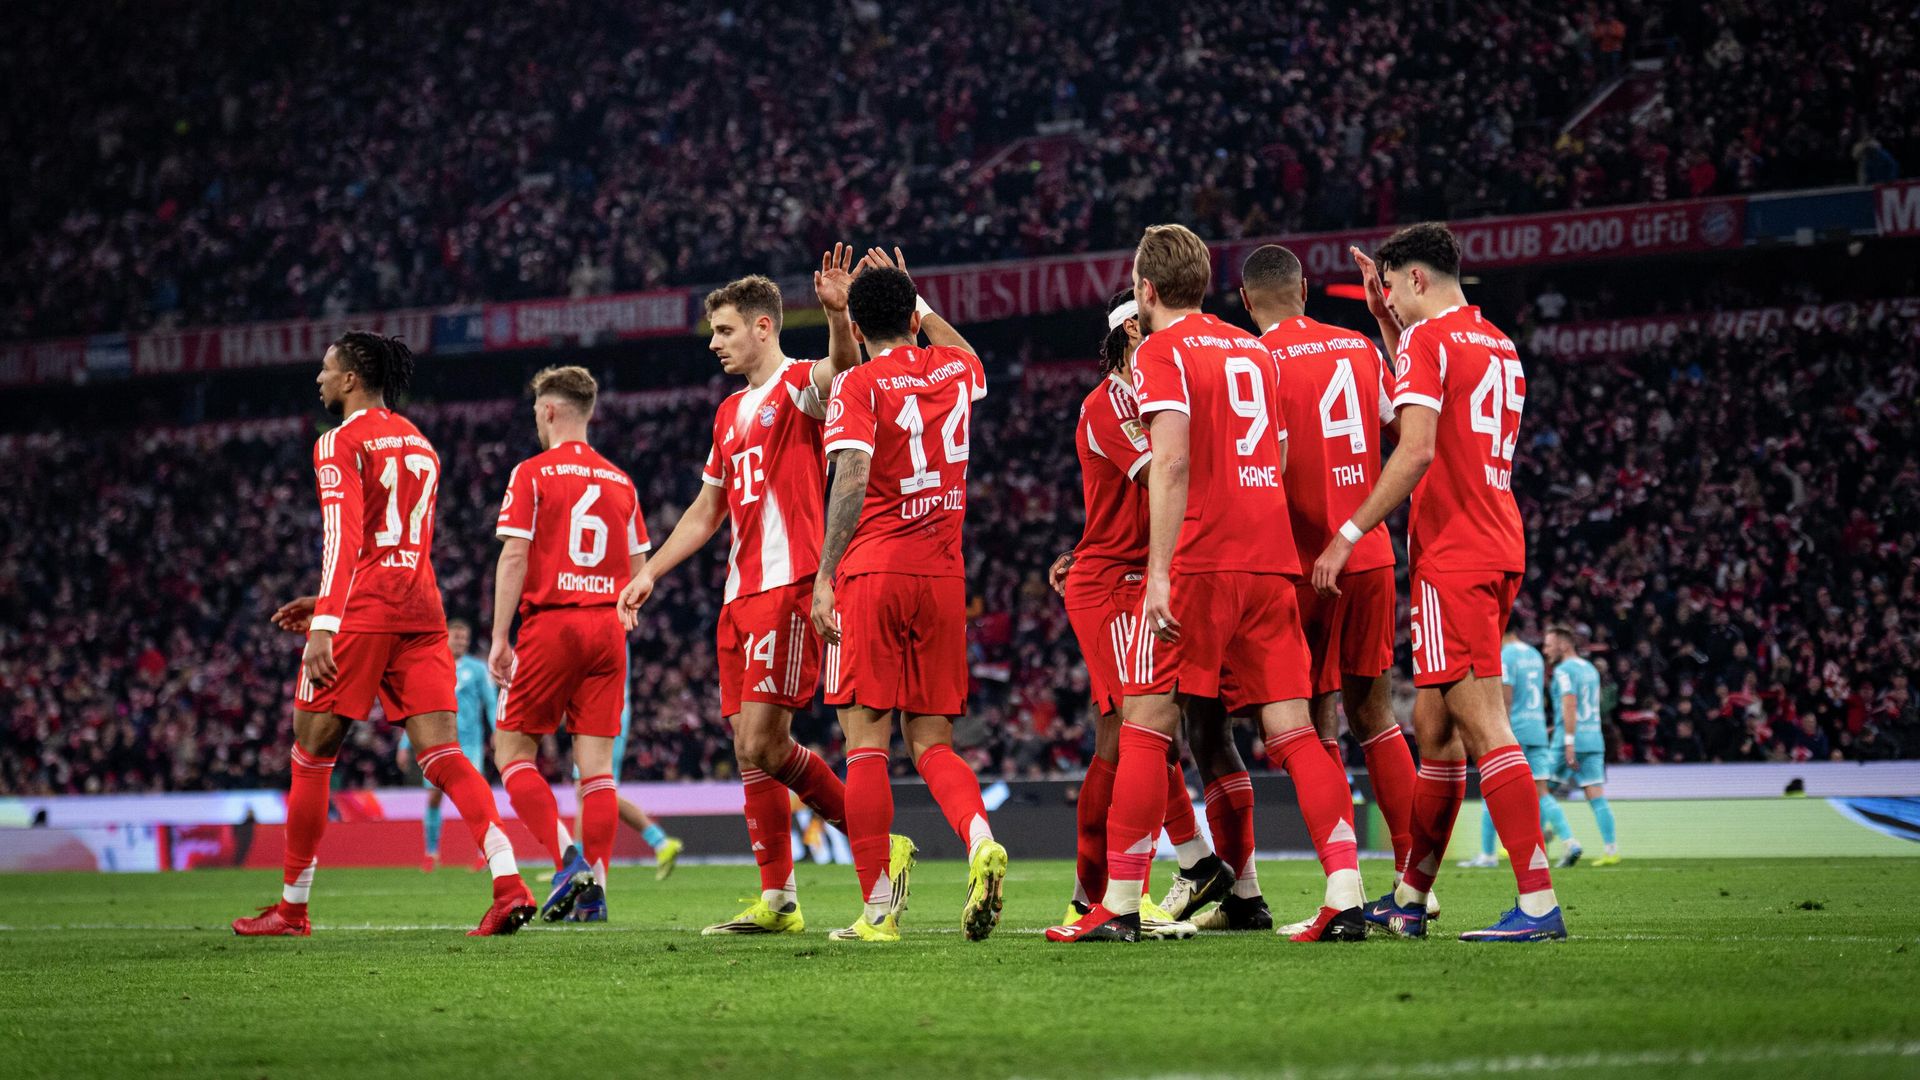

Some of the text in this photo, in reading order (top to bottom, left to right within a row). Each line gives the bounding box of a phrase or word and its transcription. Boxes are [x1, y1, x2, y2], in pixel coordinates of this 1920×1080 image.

[1457, 223, 1541, 262] CLUB
[1551, 216, 1624, 255] 2000
[1183, 336, 1199, 348] FC
[1450, 332, 1466, 343] FC
[1271, 349, 1286, 362] FC
[1286, 341, 1326, 357] BAYERN
[877, 379, 891, 390] FC
[1224, 356, 1269, 457] 9
[1318, 357, 1367, 455] 4
[1470, 354, 1525, 461] 45
[363, 440, 376, 452] FC
[895, 382, 969, 495] 14
[541, 465, 554, 476] FC
[556, 464, 591, 478] BAYERN
[1238, 465, 1278, 488] KANE
[1332, 464, 1364, 487] TAH
[375, 454, 436, 547] 17
[901, 495, 943, 519] LUIS
[568, 484, 608, 568] 6
[558, 572, 615, 594] KIMMICH
[1410, 606, 1423, 652] 5
[1526, 671, 1541, 709] 5
